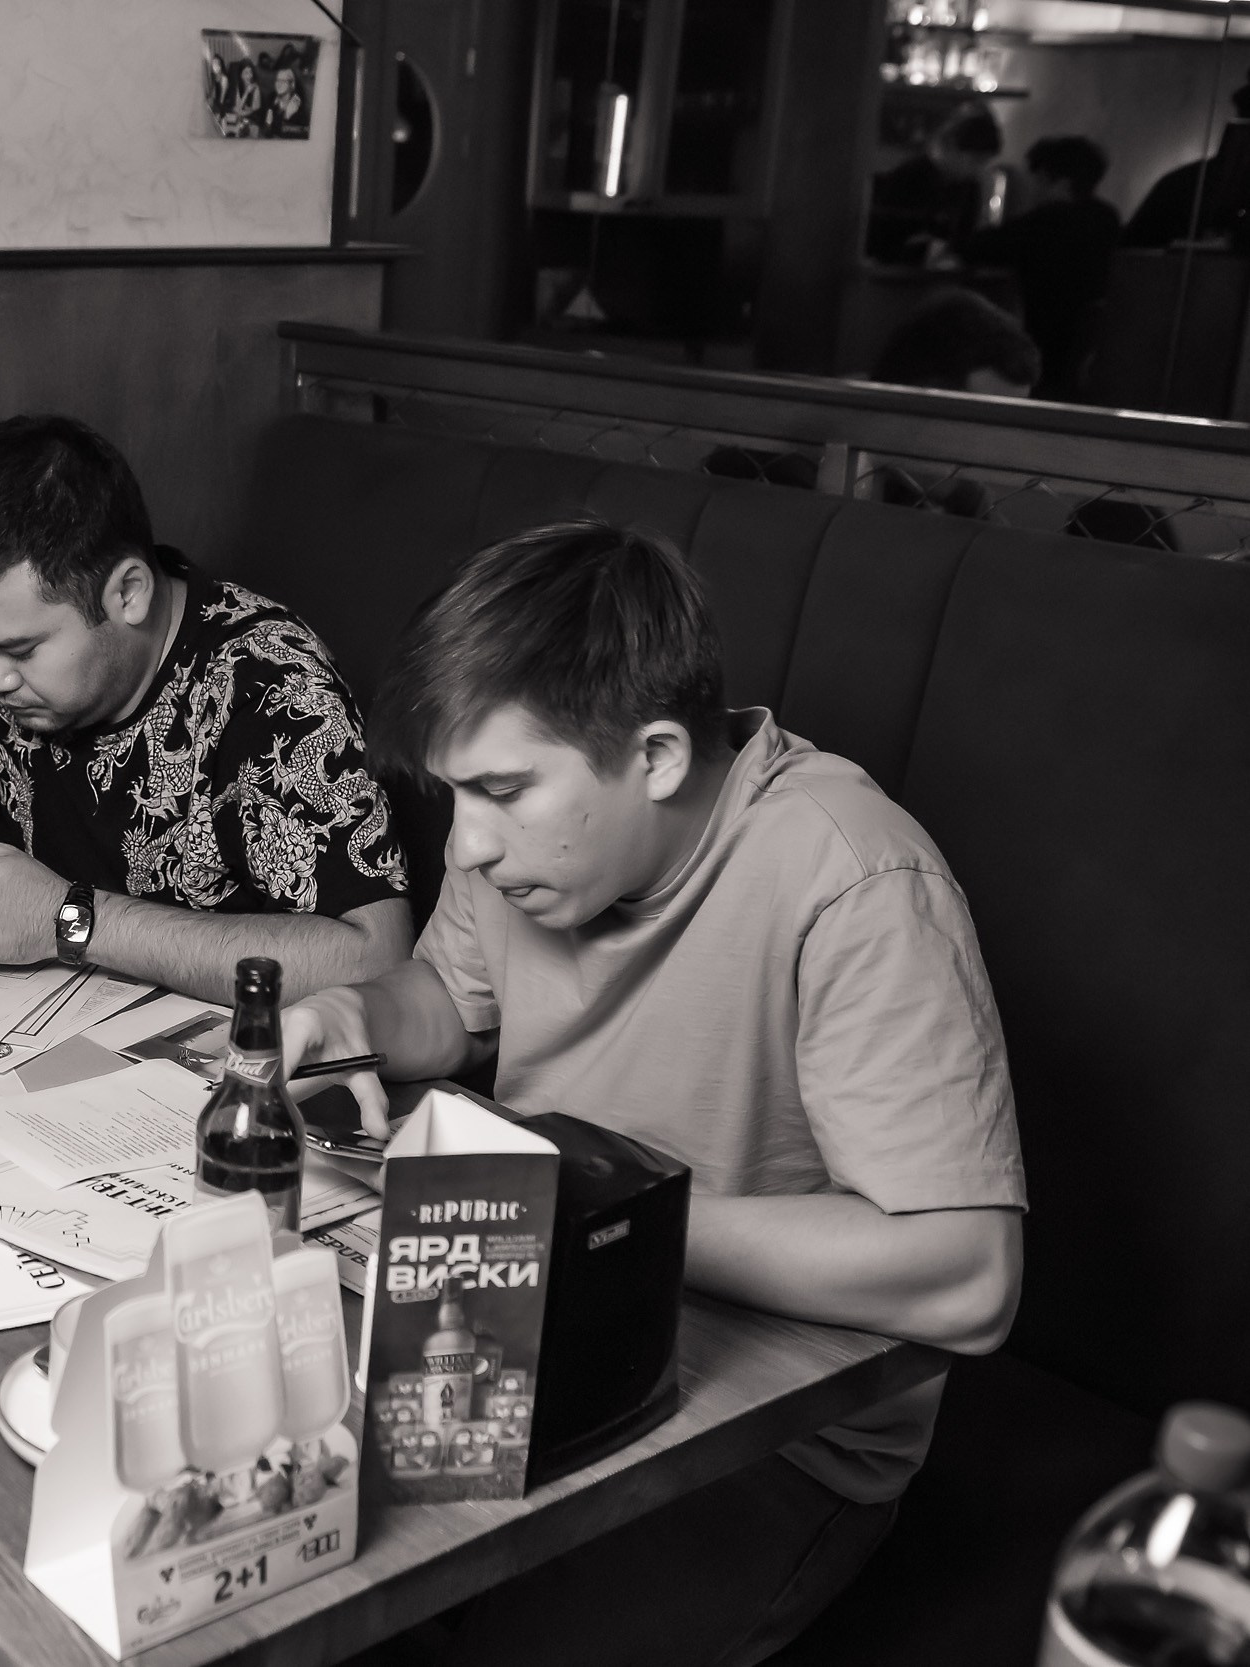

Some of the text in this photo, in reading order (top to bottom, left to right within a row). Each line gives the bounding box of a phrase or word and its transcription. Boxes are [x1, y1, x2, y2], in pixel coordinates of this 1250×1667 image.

[225, 1051, 263, 1077] Bud
[419, 1199, 520, 1223] REPUBLIC
[313, 1232, 369, 1268] EPUB
[388, 1234, 481, 1266] ЯРД
[16, 1251, 66, 1289] СЕЙ
[386, 1260, 540, 1292] ВИСКИ
[214, 1554, 269, 1604] 2+1
